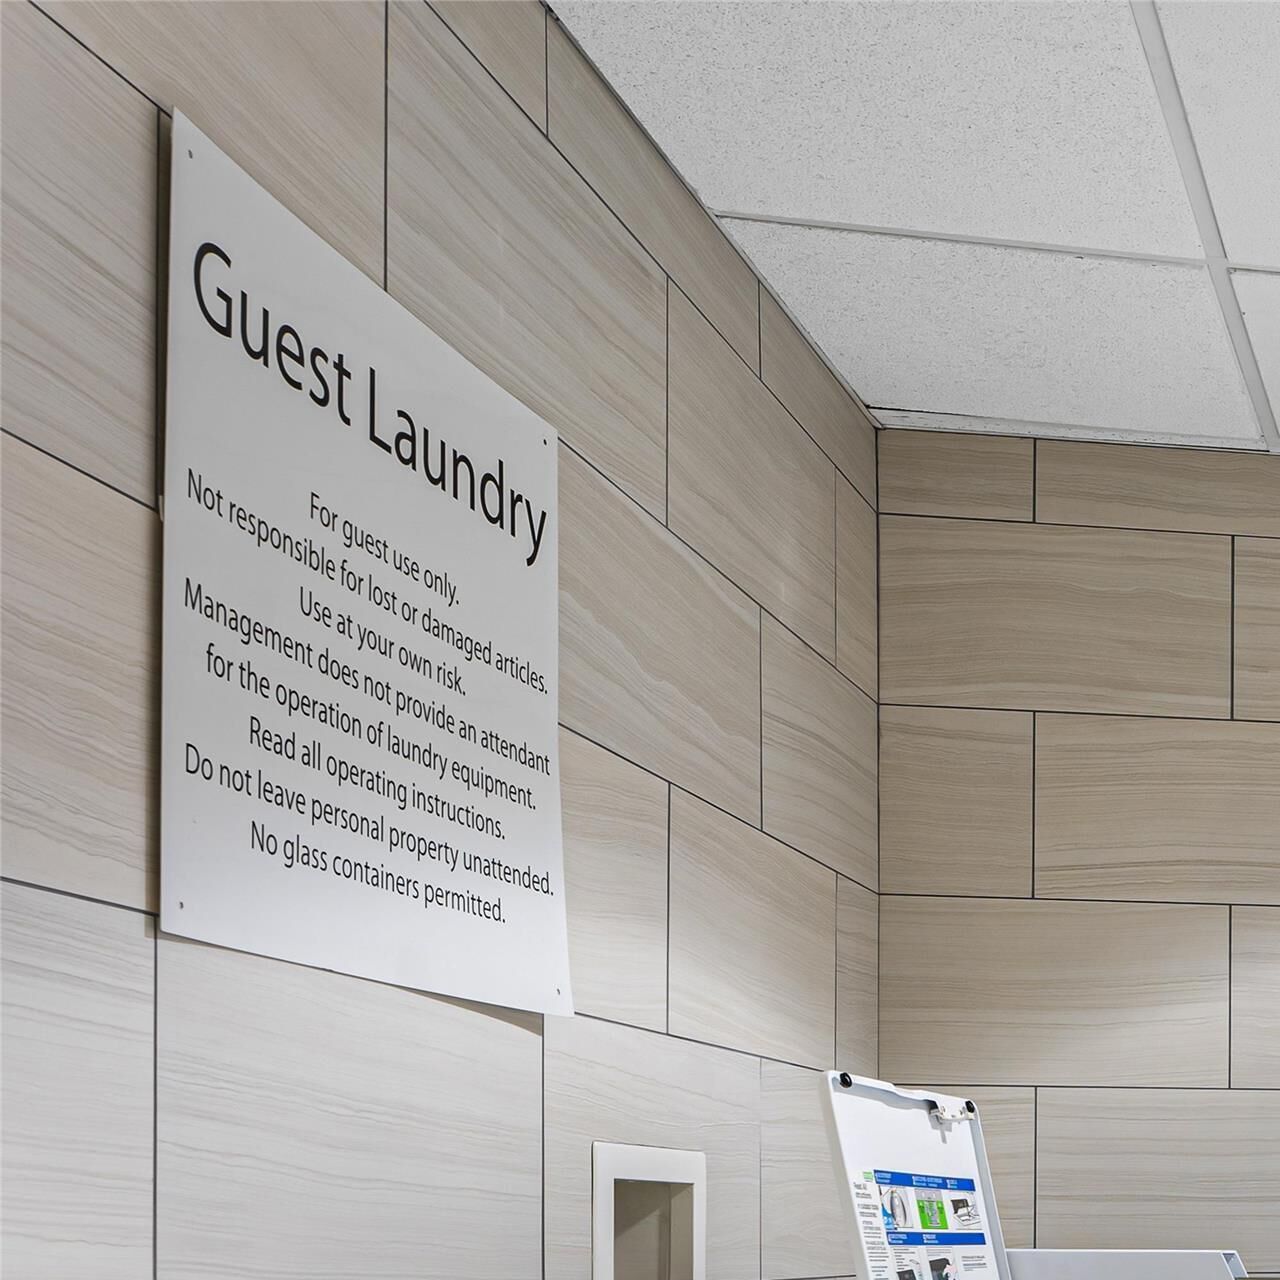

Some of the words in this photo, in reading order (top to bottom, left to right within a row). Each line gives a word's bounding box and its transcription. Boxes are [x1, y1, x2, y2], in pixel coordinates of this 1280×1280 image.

[193, 241, 352, 427] Guest
[368, 366, 547, 567] Laundry
[187, 467, 224, 518] Not
[229, 501, 336, 581] responsible
[339, 558, 365, 596] for
[368, 573, 398, 616] lost
[401, 601, 419, 626] or
[421, 607, 492, 666] damaged
[495, 652, 548, 695] articles.
[310, 491, 339, 533] For
[342, 519, 389, 565] guest
[392, 549, 420, 582] use
[423, 569, 460, 608] only.
[184, 577, 314, 669] Management
[317, 647, 360, 690] does
[363, 674, 392, 706] not
[395, 689, 456, 735] provide
[458, 720, 477, 745] an
[480, 730, 551, 777] attendant
[299, 585, 332, 629] Use
[336, 613, 354, 640] at
[356, 623, 395, 660] your
[398, 646, 432, 680] own
[436, 661, 466, 697] risk.
[205, 642, 234, 682] for
[238, 660, 271, 699] the
[275, 683, 362, 740] operation
[366, 720, 385, 748] of
[387, 724, 448, 781] laundry
[451, 760, 537, 811] equipment.
[249, 715, 296, 761] Read
[301, 739, 321, 771] all
[326, 755, 408, 811] operating
[411, 782, 506, 841] instructions.
[185, 742, 214, 781] Do
[219, 763, 253, 797] not
[257, 769, 306, 815] leave
[311, 798, 384, 843] personal
[389, 826, 460, 873] property
[463, 851, 554, 897] unattended.
[251, 820, 278, 856] No
[283, 833, 328, 872] glass
[332, 855, 420, 900] containers
[424, 883, 506, 924] permitted.
